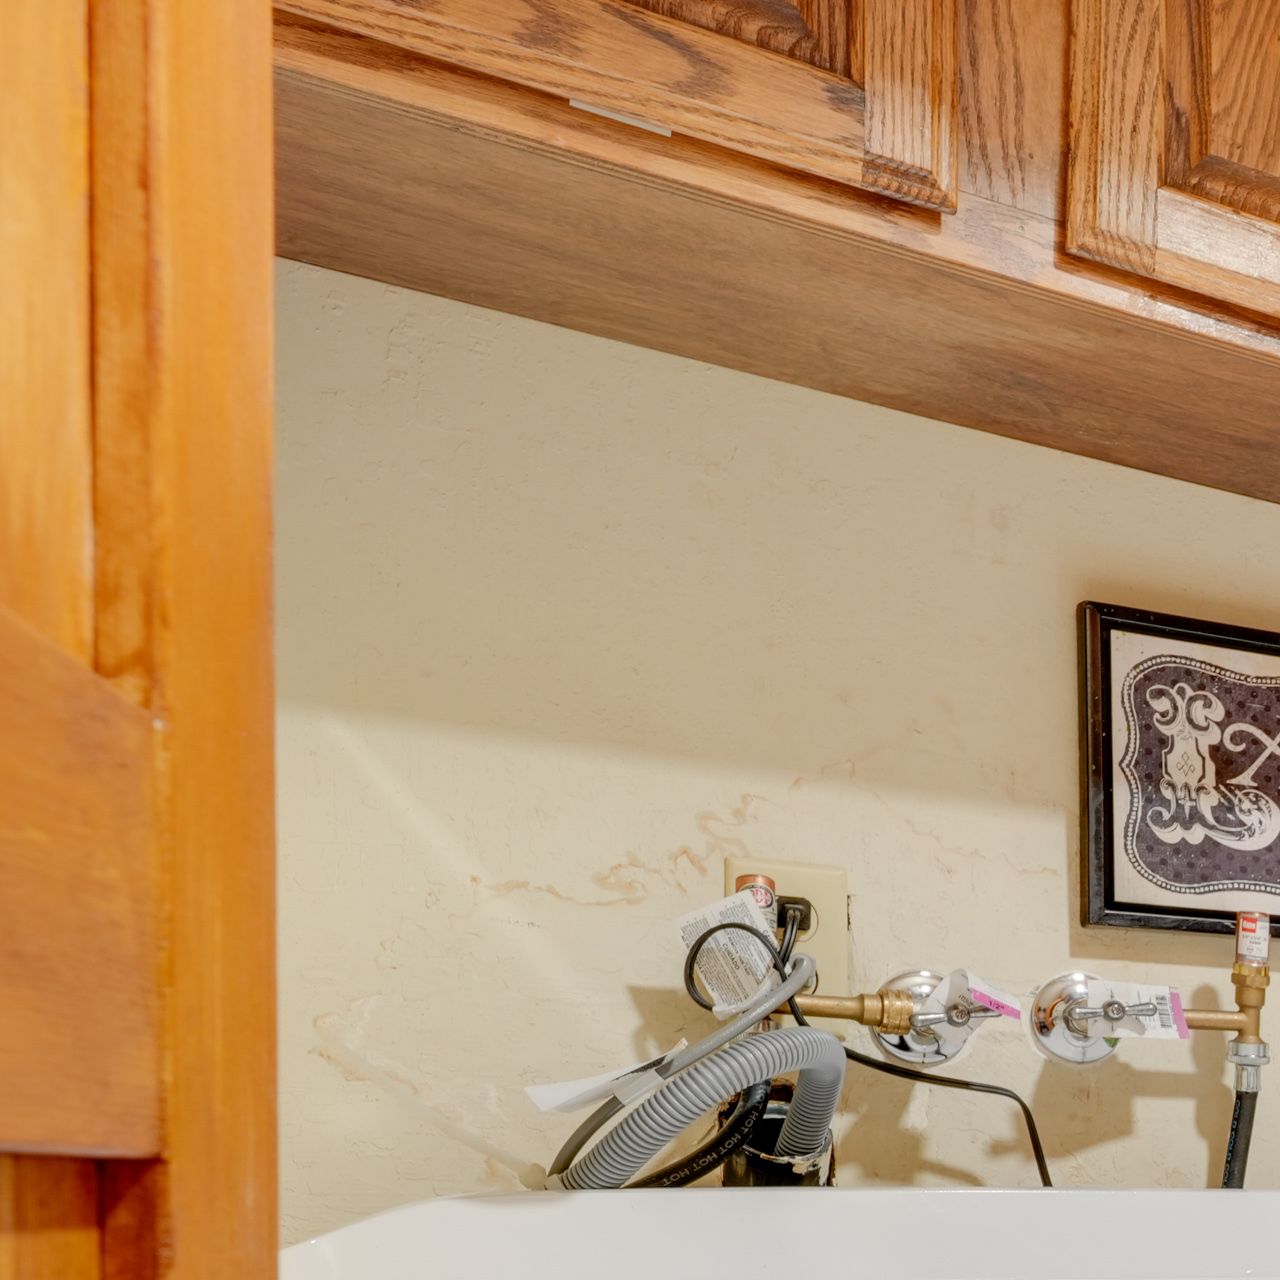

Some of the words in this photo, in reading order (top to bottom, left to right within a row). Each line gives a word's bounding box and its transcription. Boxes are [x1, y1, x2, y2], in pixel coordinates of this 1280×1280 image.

[740, 1111, 759, 1135] HOT
[719, 1133, 741, 1155] HOT
[693, 1151, 718, 1172] HOT
[663, 1168, 690, 1187] HOT
